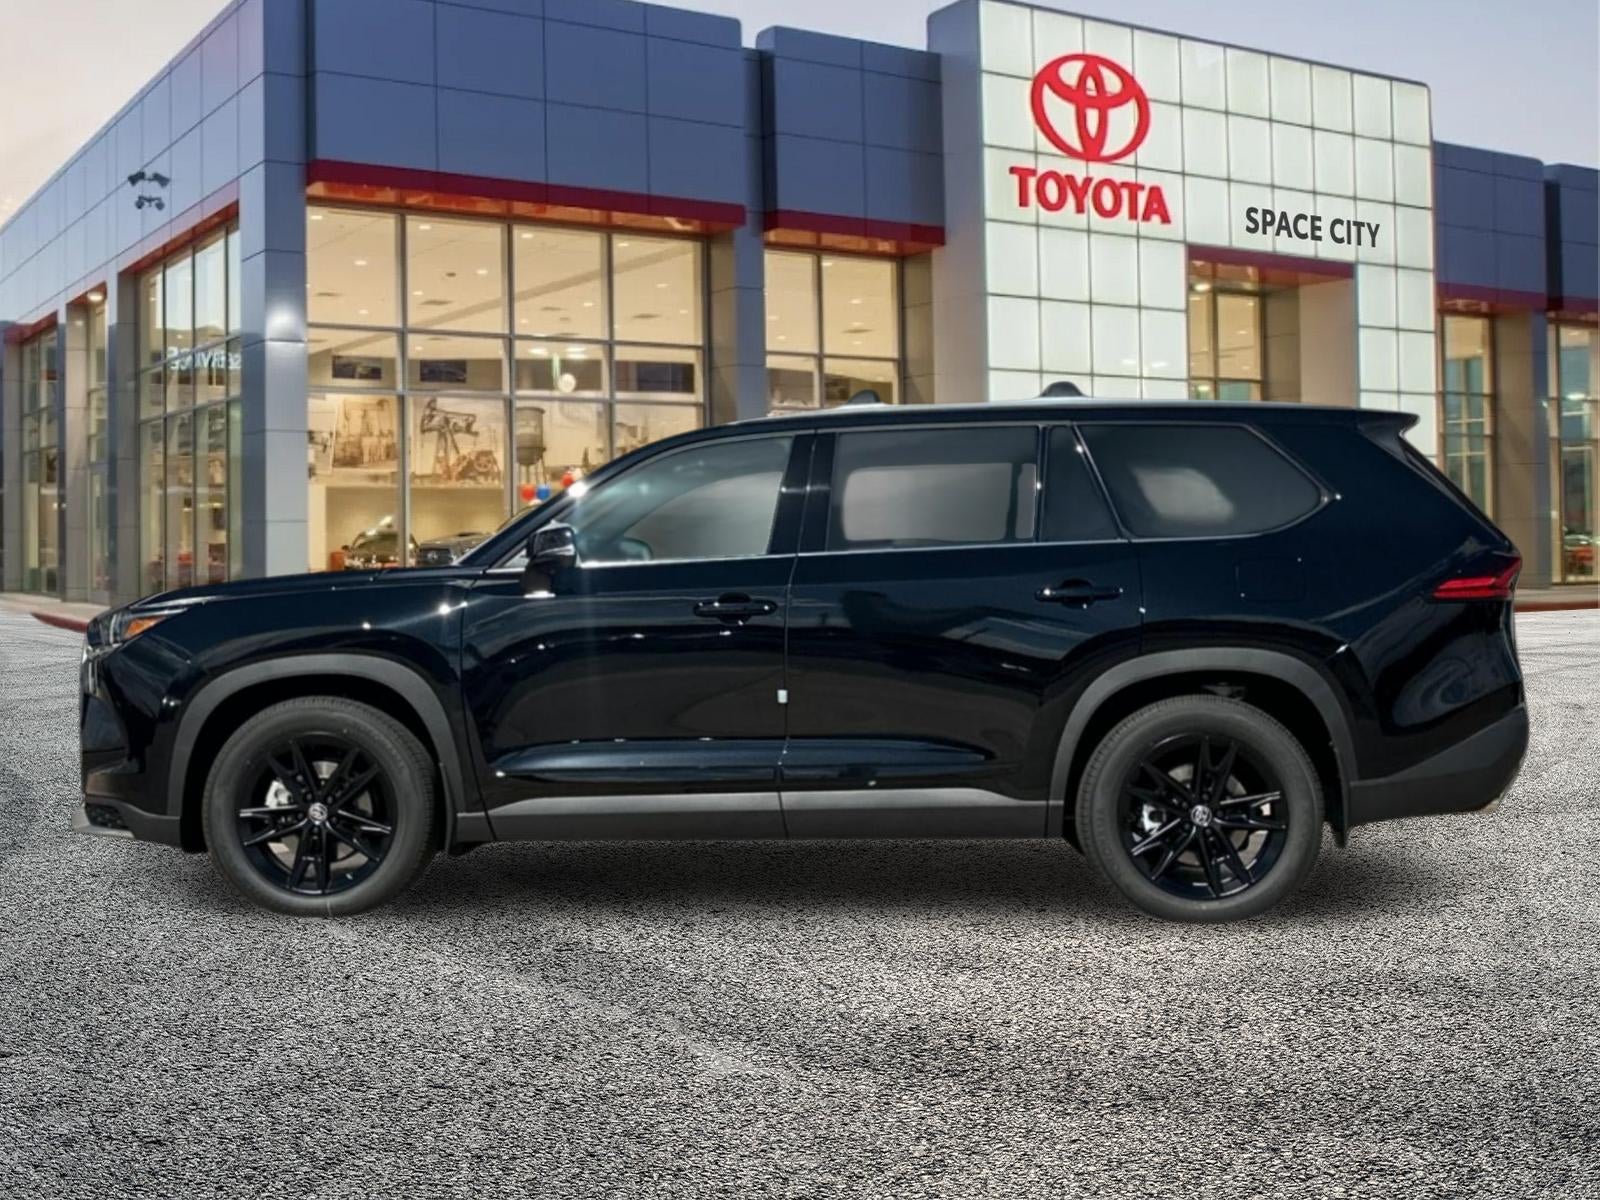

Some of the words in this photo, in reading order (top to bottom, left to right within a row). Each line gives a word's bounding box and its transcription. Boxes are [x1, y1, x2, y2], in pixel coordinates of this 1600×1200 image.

[1009, 166, 1171, 224] TOYOTA
[1245, 206, 1324, 242] SPACE
[1329, 218, 1381, 248] CITY
